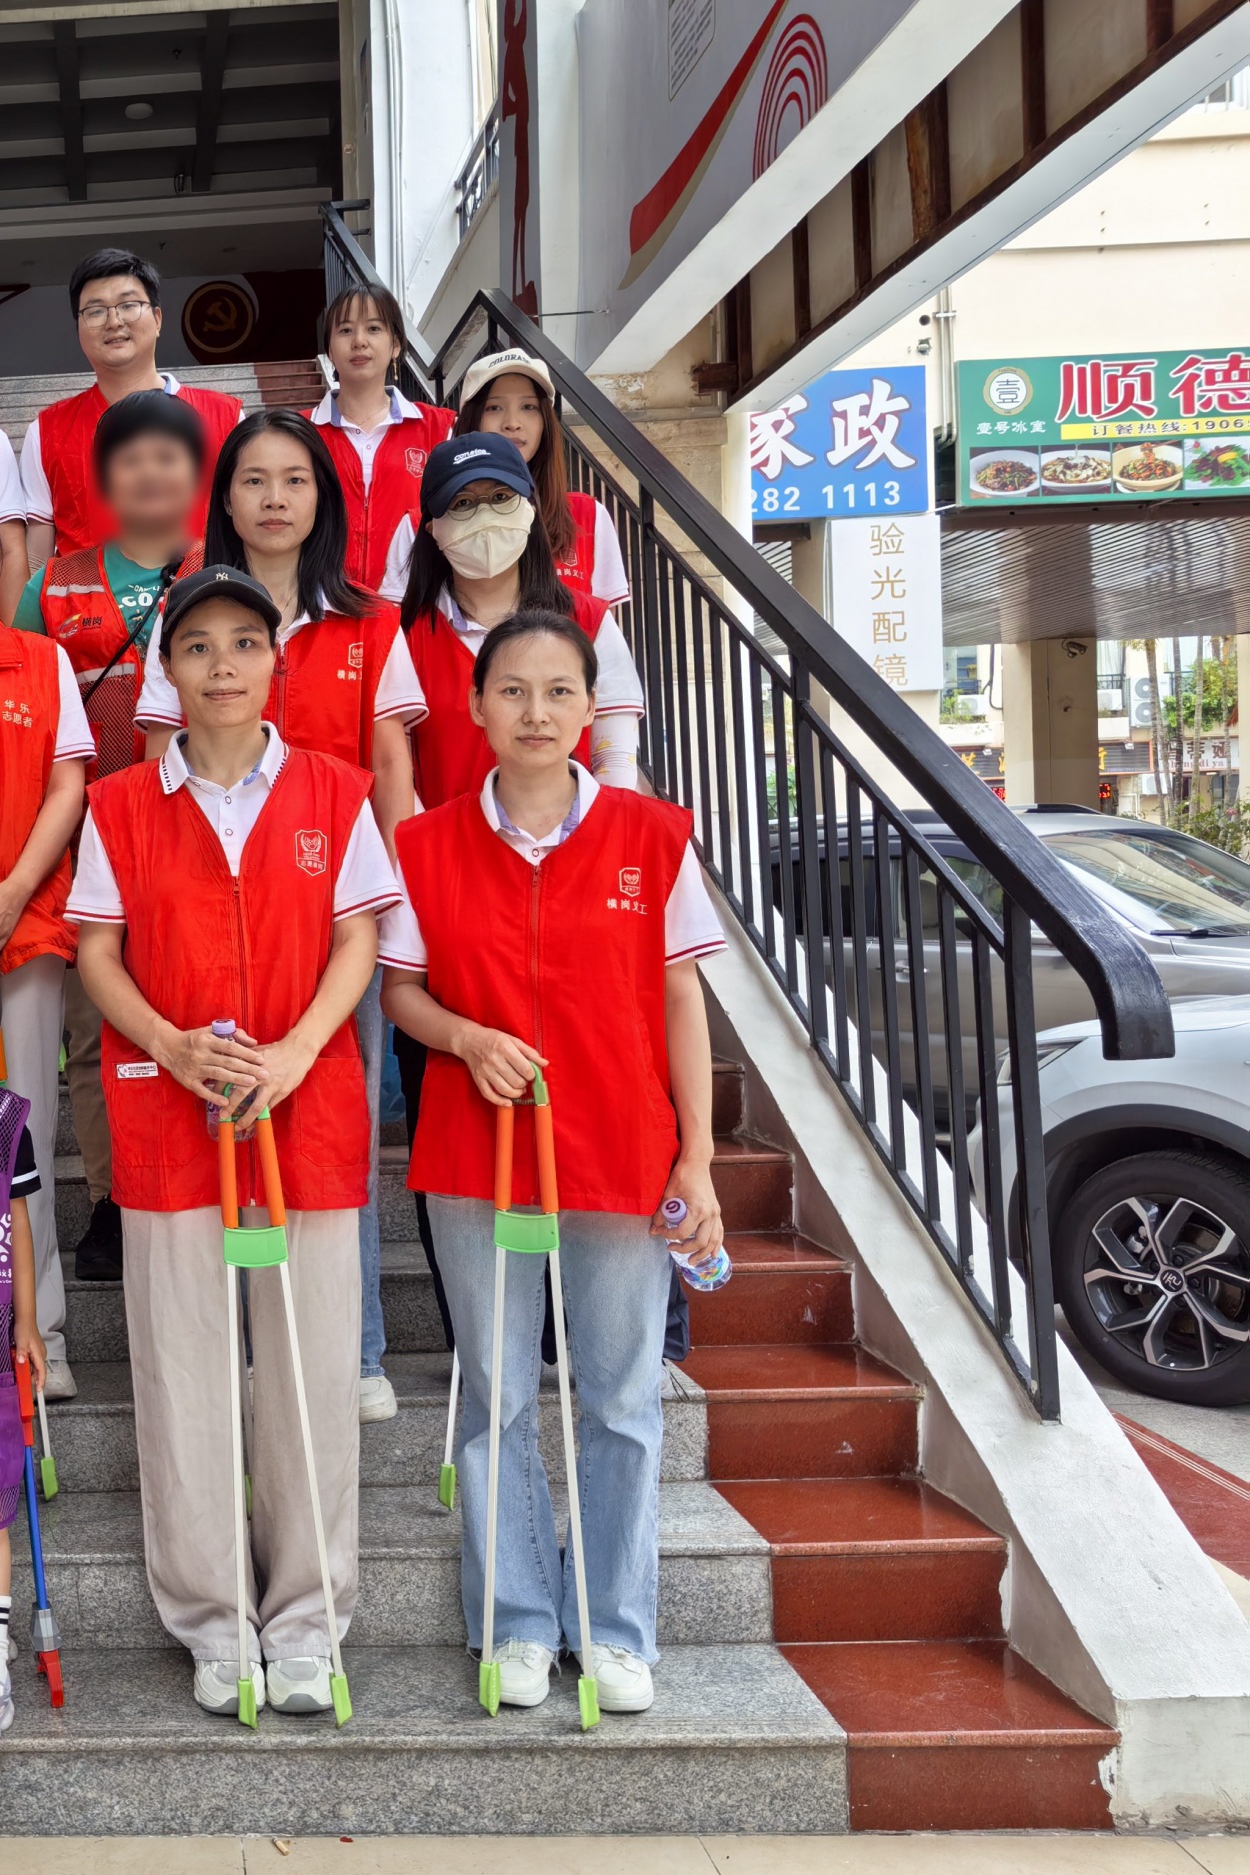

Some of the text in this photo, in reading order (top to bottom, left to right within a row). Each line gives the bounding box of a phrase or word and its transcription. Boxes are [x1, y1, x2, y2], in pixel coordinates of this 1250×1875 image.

[1055, 352, 1250, 422] 顺德
[976, 420, 1046, 435] 壹号冰室
[1093, 418, 1250, 437] 订餐热线:1906
[822, 481, 900, 509] 1113
[869, 522, 908, 687] 验光配镜
[1, 710, 33, 728] 志愿者
[606, 898, 648, 915] 横岗义工
